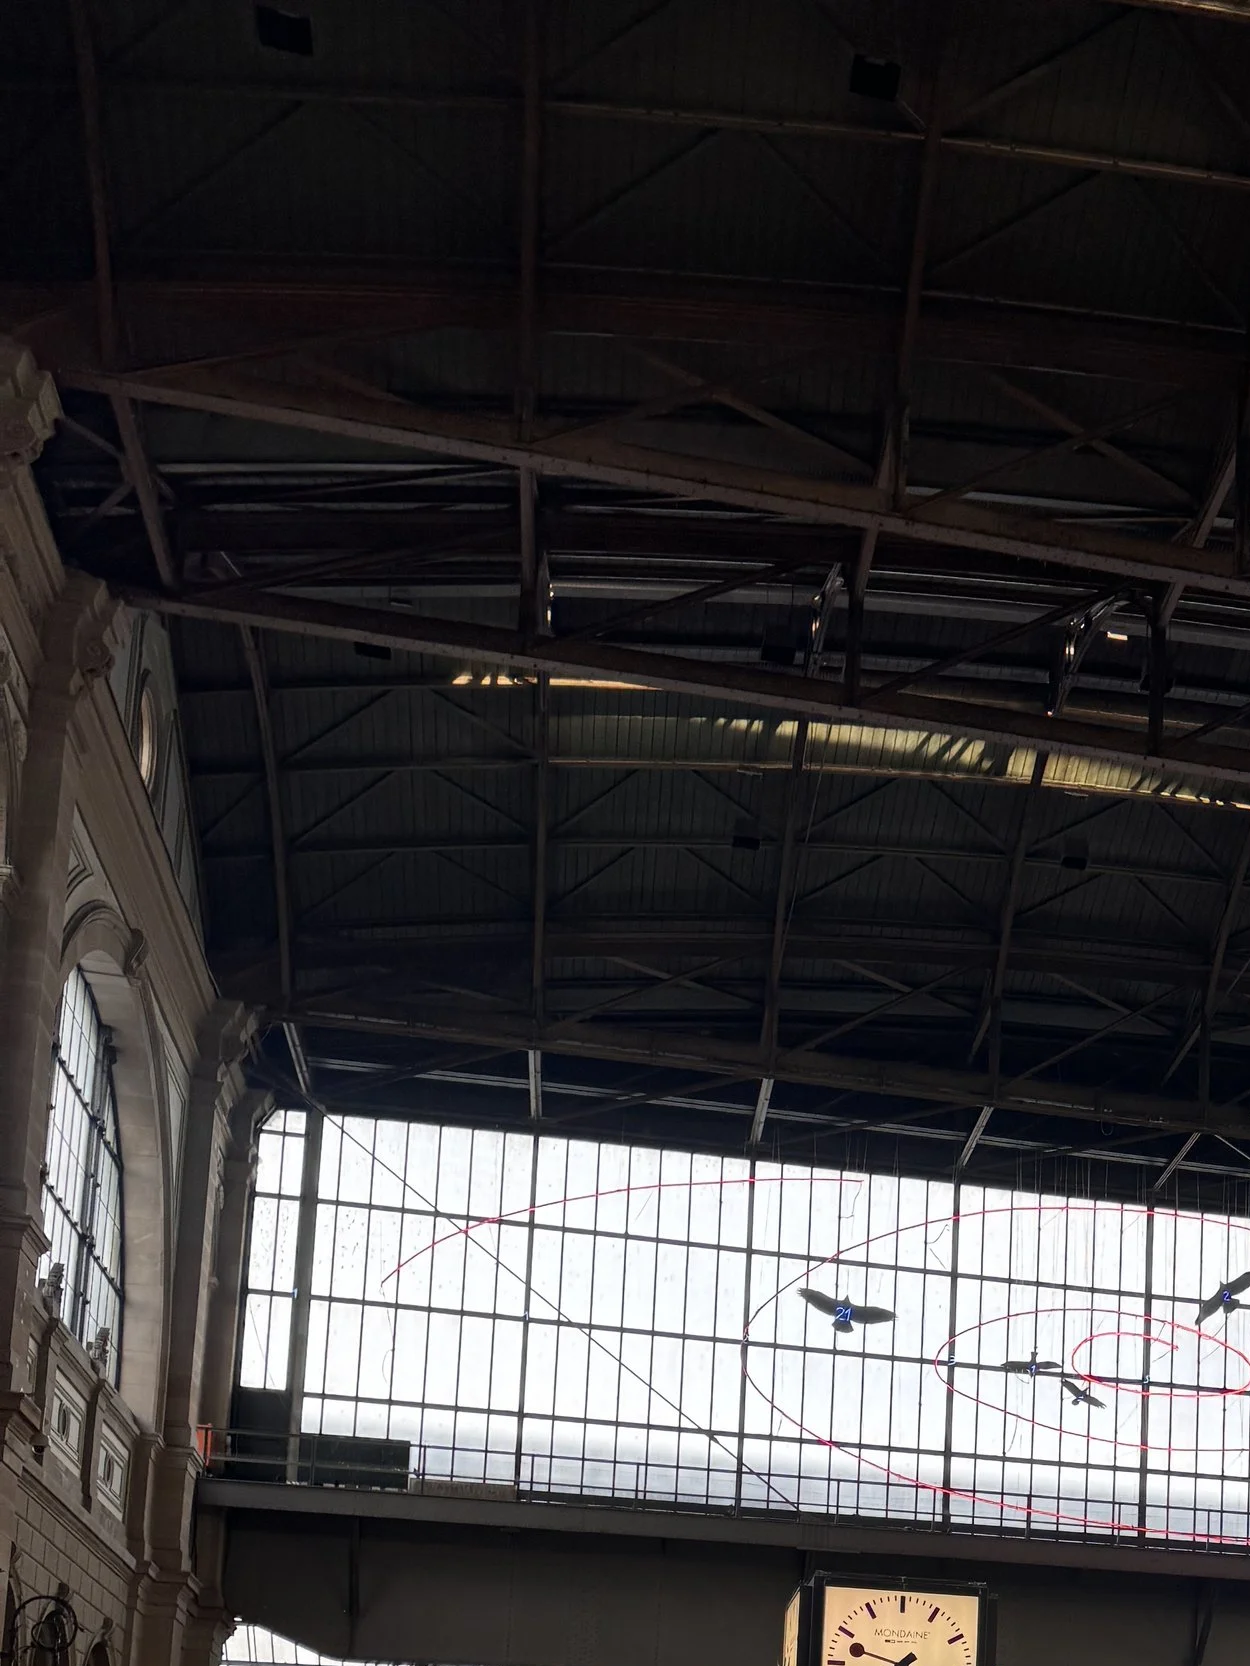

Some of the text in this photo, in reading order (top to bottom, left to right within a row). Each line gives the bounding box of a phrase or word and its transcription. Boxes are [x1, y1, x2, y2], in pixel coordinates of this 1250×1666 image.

[1223, 1291, 1230, 1301] 2
[836, 1307, 852, 1321] 21
[874, 1628, 928, 1640] MONDAINE
